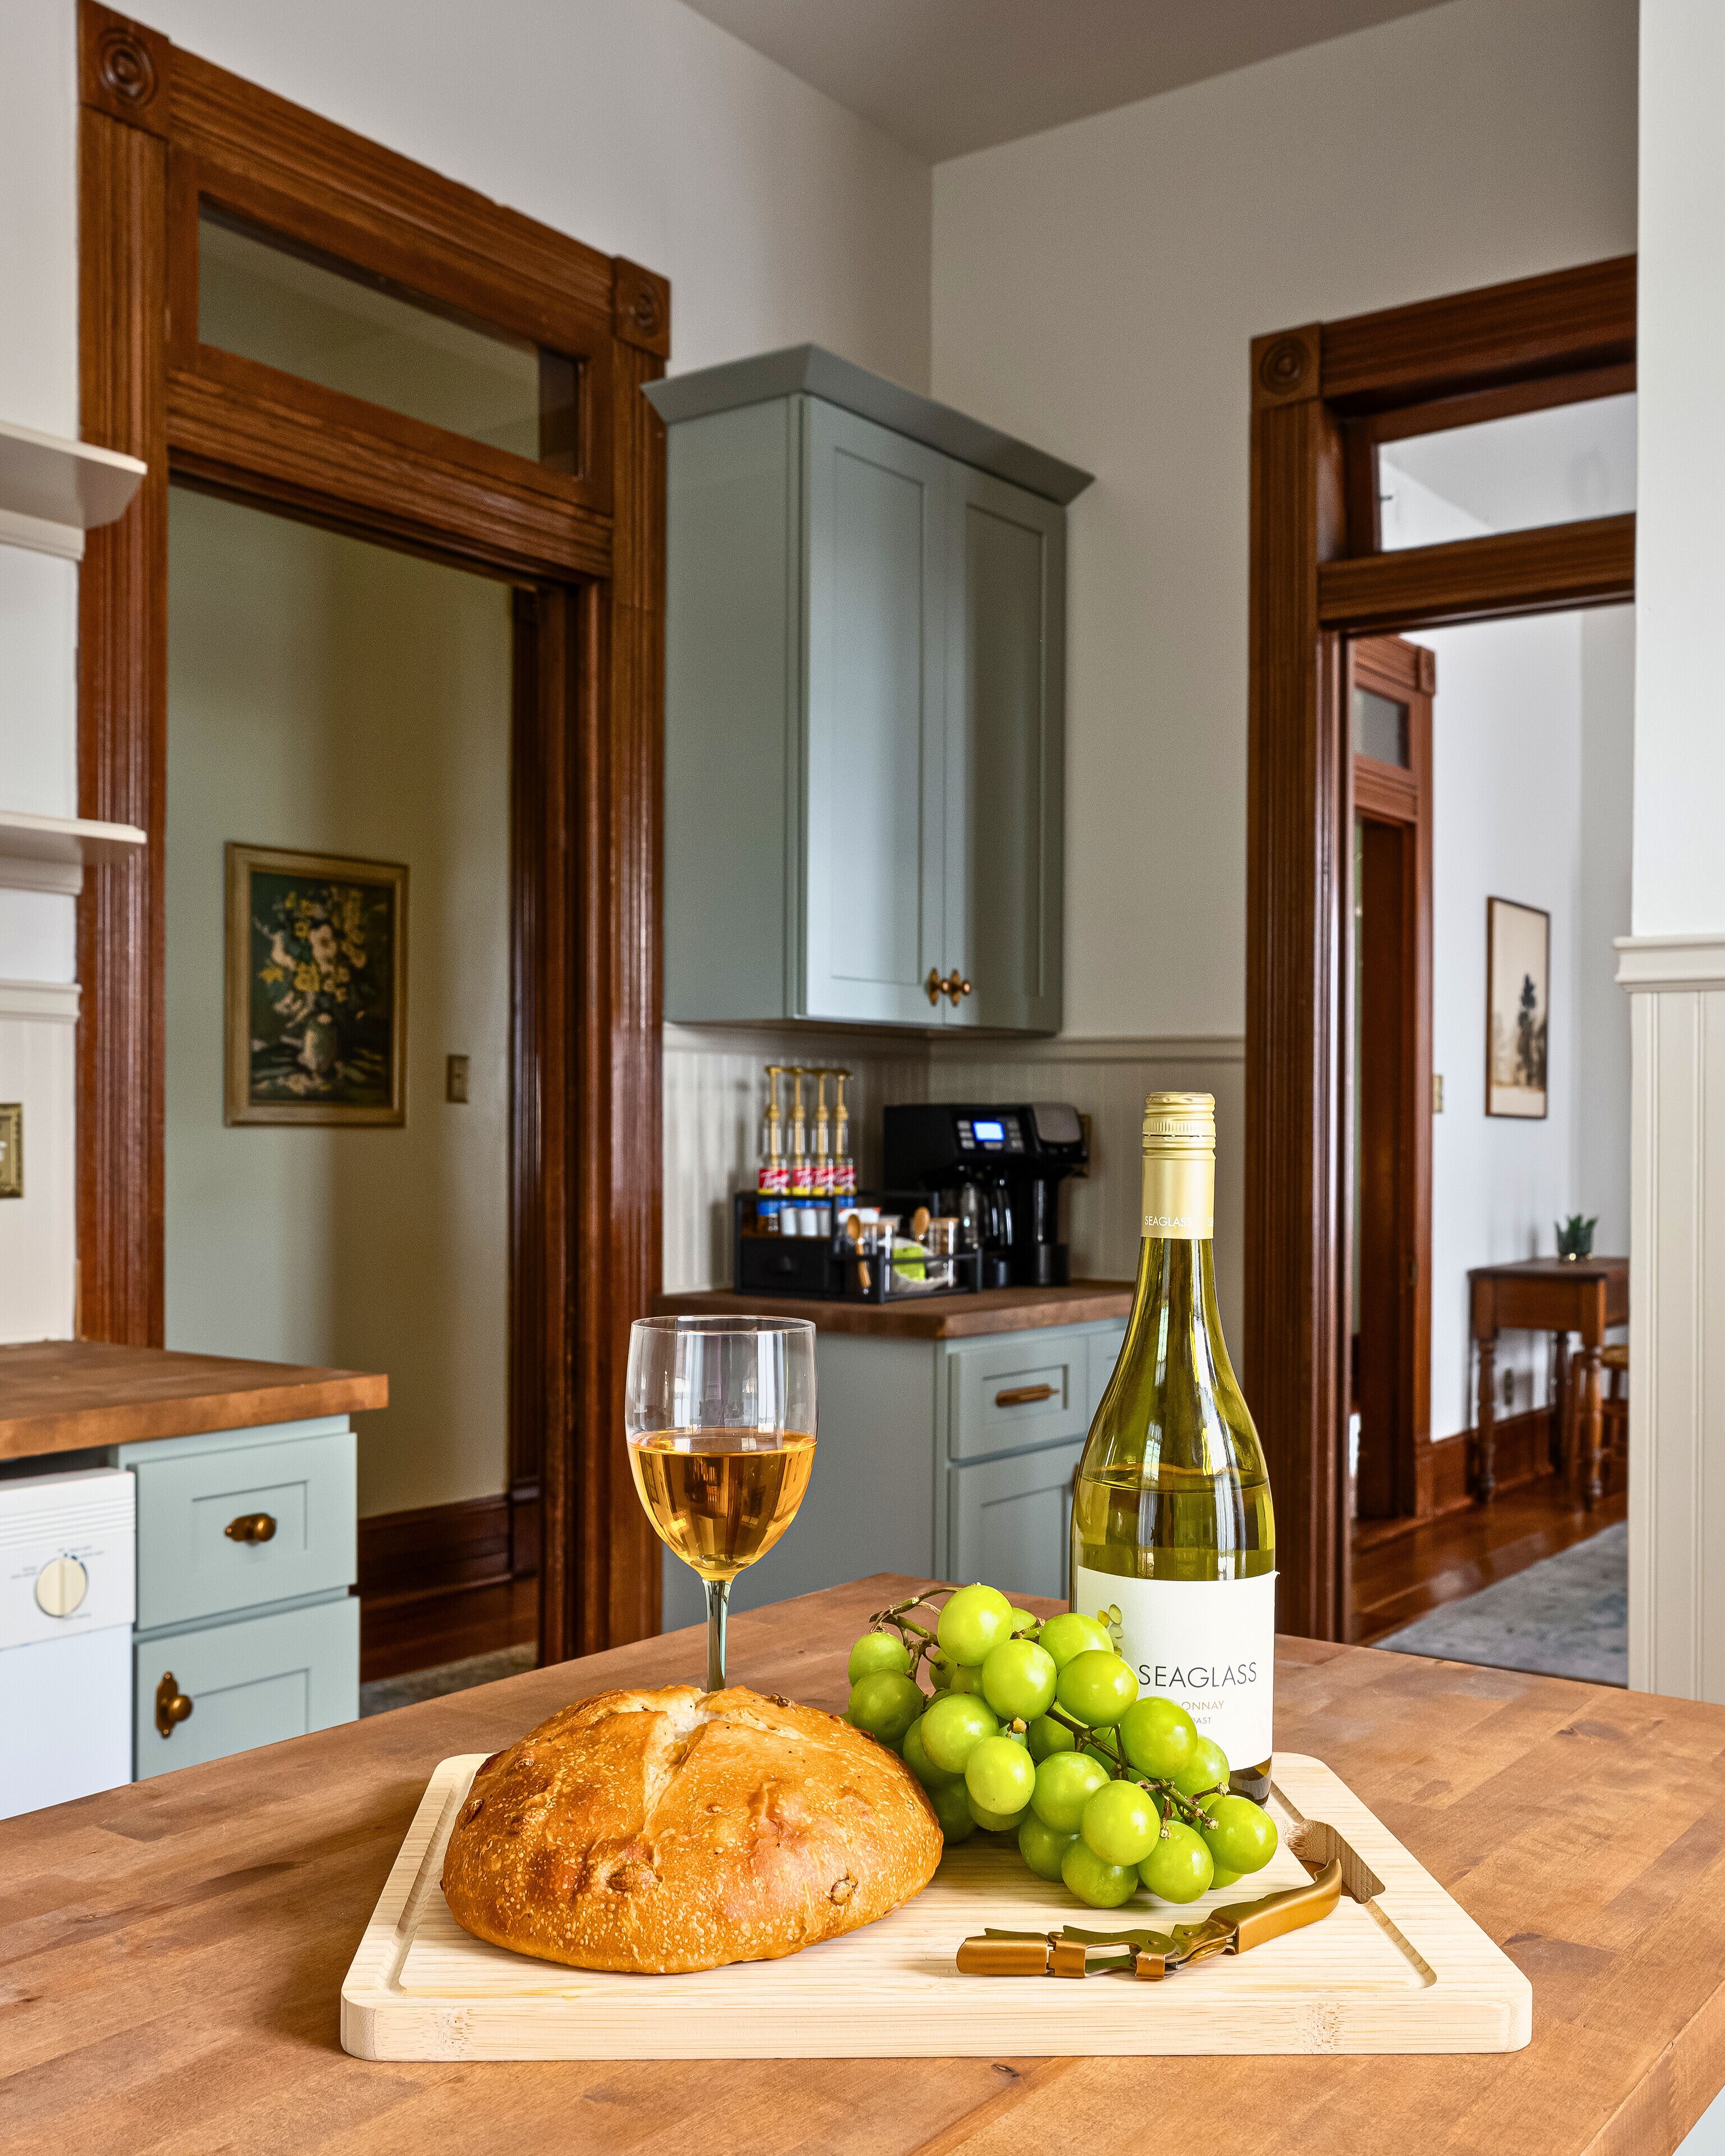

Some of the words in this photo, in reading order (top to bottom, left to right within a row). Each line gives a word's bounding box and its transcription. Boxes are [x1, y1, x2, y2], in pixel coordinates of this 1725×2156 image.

[1144, 1216, 1193, 1227] SEAGLASS
[1138, 1662, 1257, 1688] SEAGLASS
[1181, 1700, 1225, 1711] ONNAY
